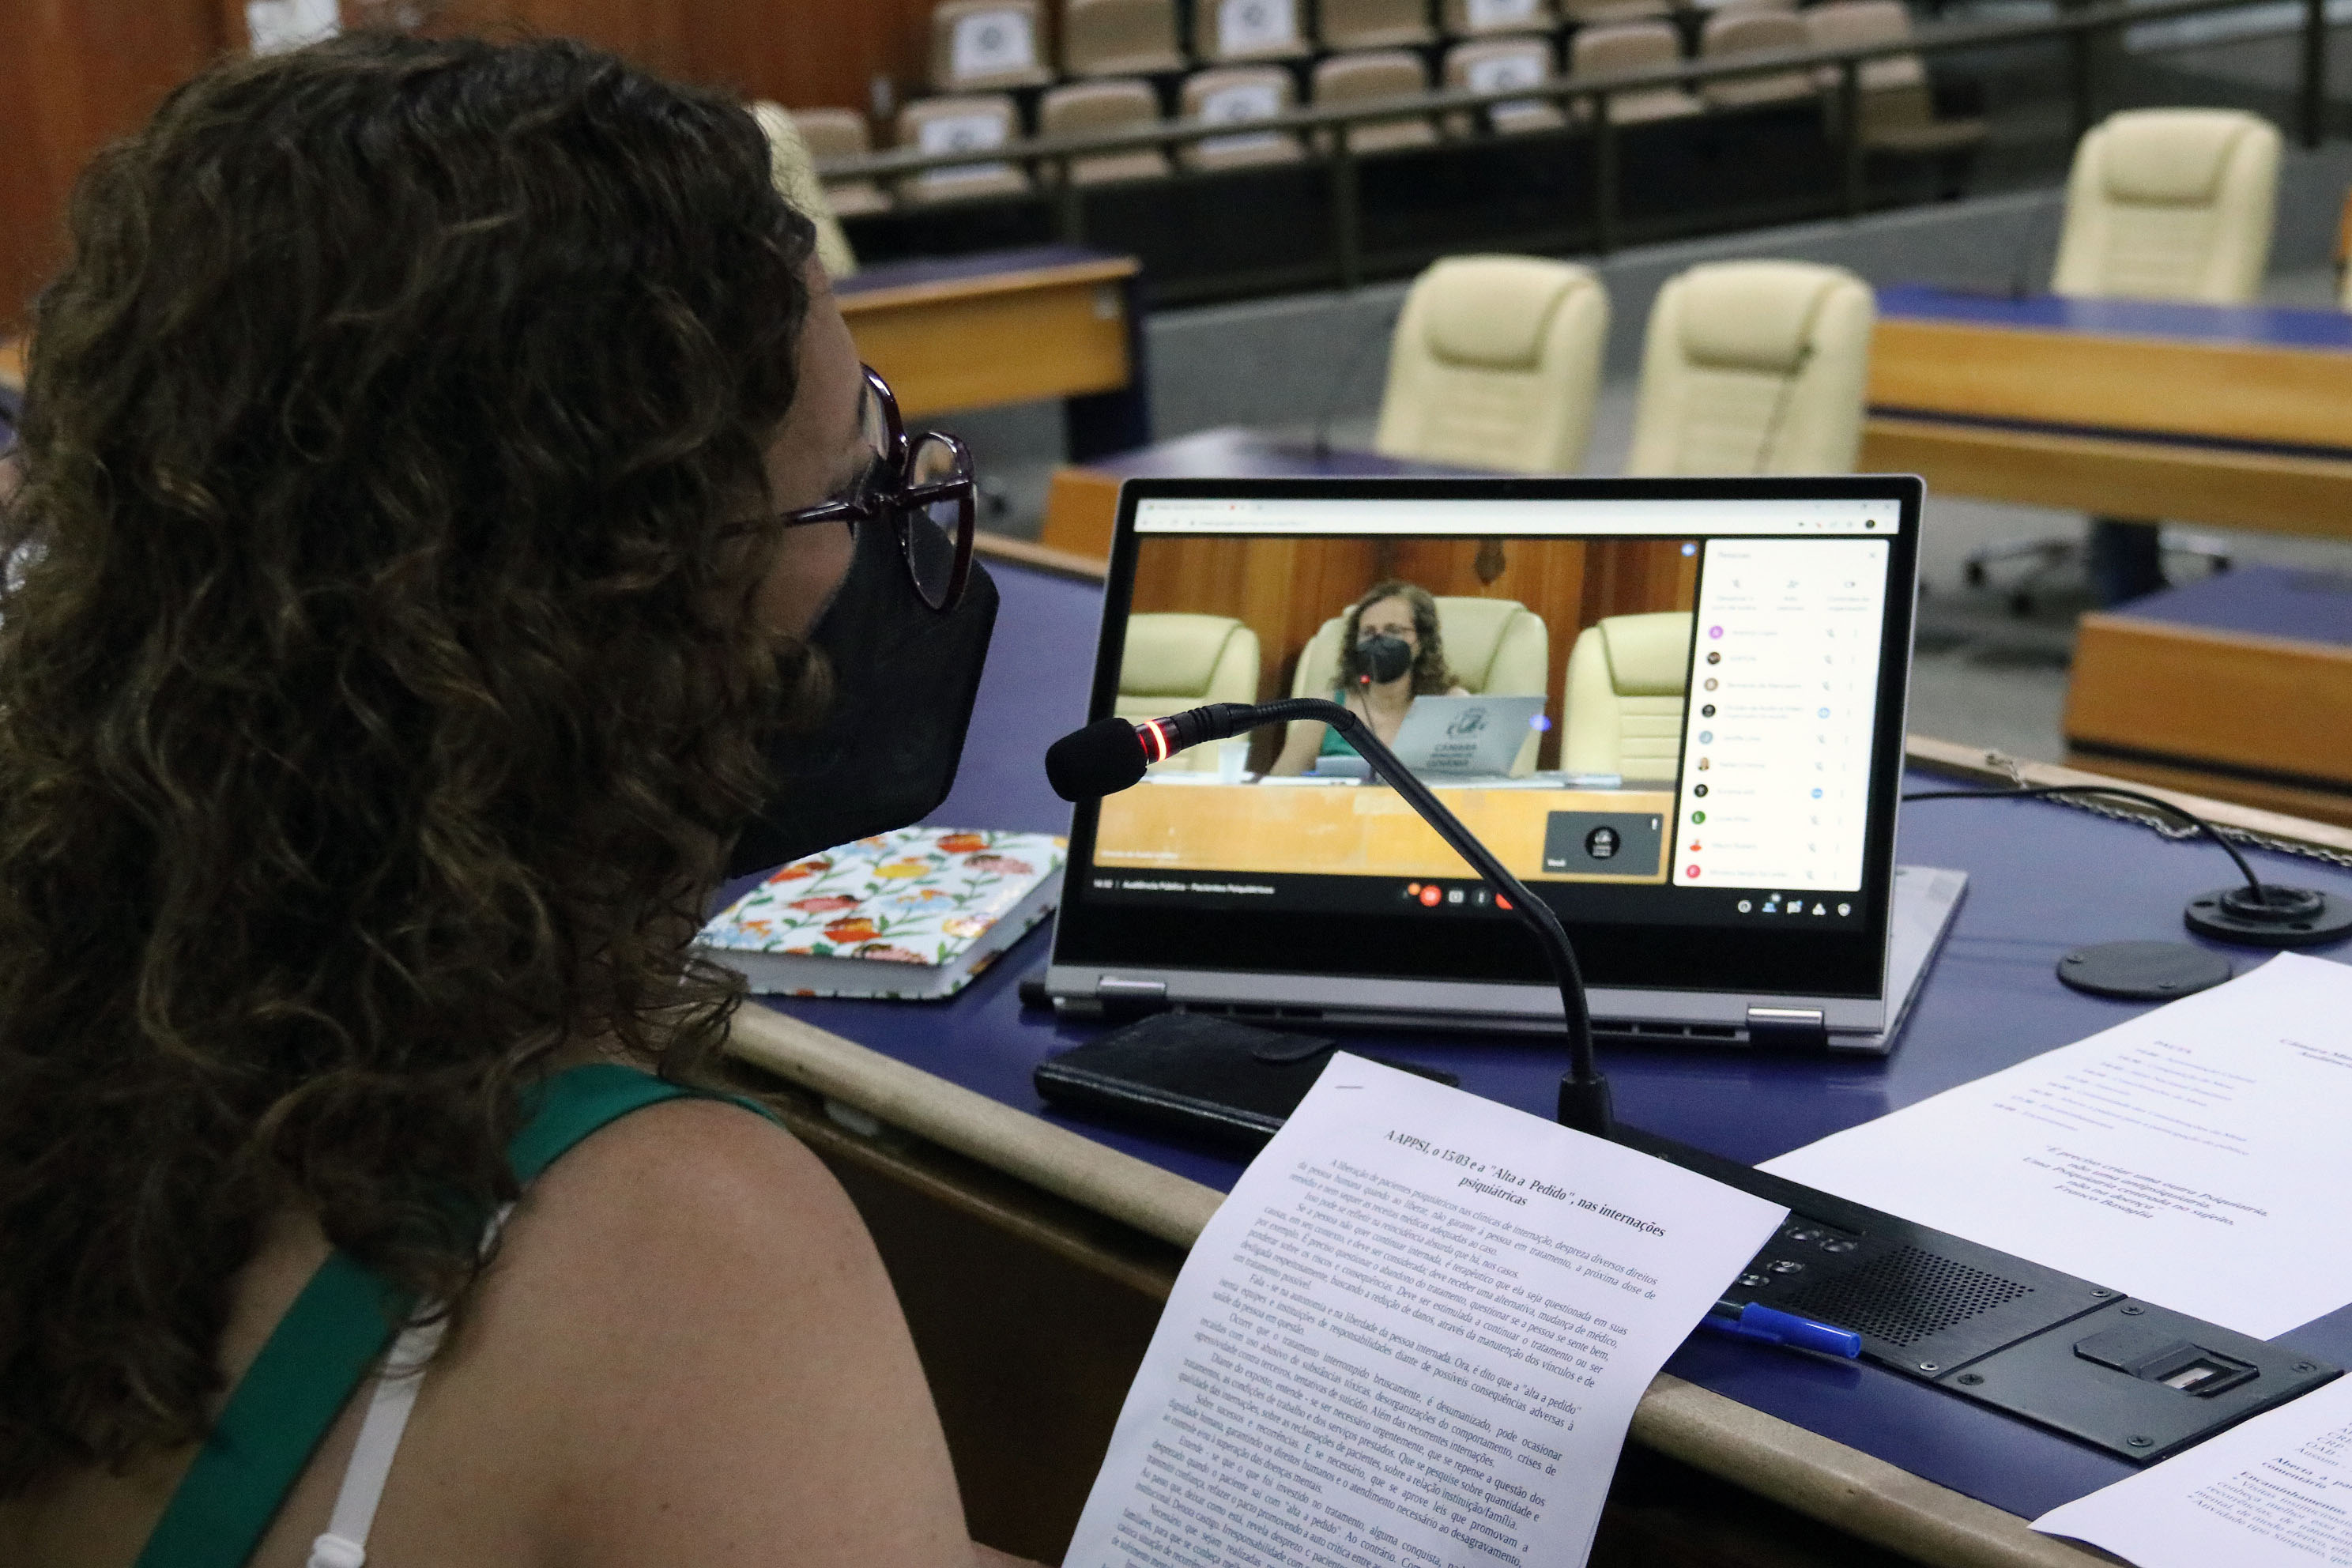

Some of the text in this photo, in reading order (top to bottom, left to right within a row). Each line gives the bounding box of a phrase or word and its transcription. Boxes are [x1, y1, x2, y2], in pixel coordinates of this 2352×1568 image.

[1386, 1129, 1666, 1237] A APPSI, o 15/03 e a "Alta a Pedido", nas internações
[1457, 1176, 1528, 1206] psiquiátricas
[2117, 1186, 2172, 1206] centrada
[2172, 1203, 2190, 1212] no
[1453, 1250, 1470, 1261] que
[1484, 1231, 1657, 1300] pessoa em próxima dose de
[1501, 1220, 1658, 1286] de despreza diversos direitos
[1396, 1285, 1418, 1301] Deve
[1418, 1296, 1431, 1306] ser
[1431, 1302, 1474, 1324] estimulada
[1482, 1321, 1521, 1341] continuar
[1521, 1336, 1529, 1345] o
[1529, 1339, 1574, 1363] tratamento
[1574, 1358, 1588, 1369] ou
[1589, 1363, 1604, 1374] ser
[1446, 1276, 1618, 1349] receber uma mudança de médico,
[1468, 1300, 1609, 1362] questionar se pessoa se sente bem,
[1494, 1280, 1628, 1336] que ela seja questionada em suas
[1388, 1332, 1582, 1415] pessoa Ora, é dito que a "alta a pedido"
[1400, 1303, 1596, 1389] de da manutenção dos vínculos e de
[1372, 1372, 1563, 1461] bruscamente, é desumanizado, pode ocasionar
[1393, 1349, 1565, 1428] diante de possíveis consequências adversas
[1370, 1405, 1494, 1468] Além das recorrentes internações.
[1374, 1390, 1557, 1476] desorganizações do comportamento, crises de
[1348, 1483, 1450, 1535] atendimento necessário ao
[1382, 1464, 1442, 1495] sobre relação
[1397, 1451, 1540, 1522] Que pesquise sobre quantidade e
[1427, 1449, 1546, 1507] que se repense a questão dos
[1344, 1530, 1358, 1544] Ao
[1368, 1525, 1399, 1547] alguma
[1370, 1475, 1529, 1553] que aprove leis que promovam a
